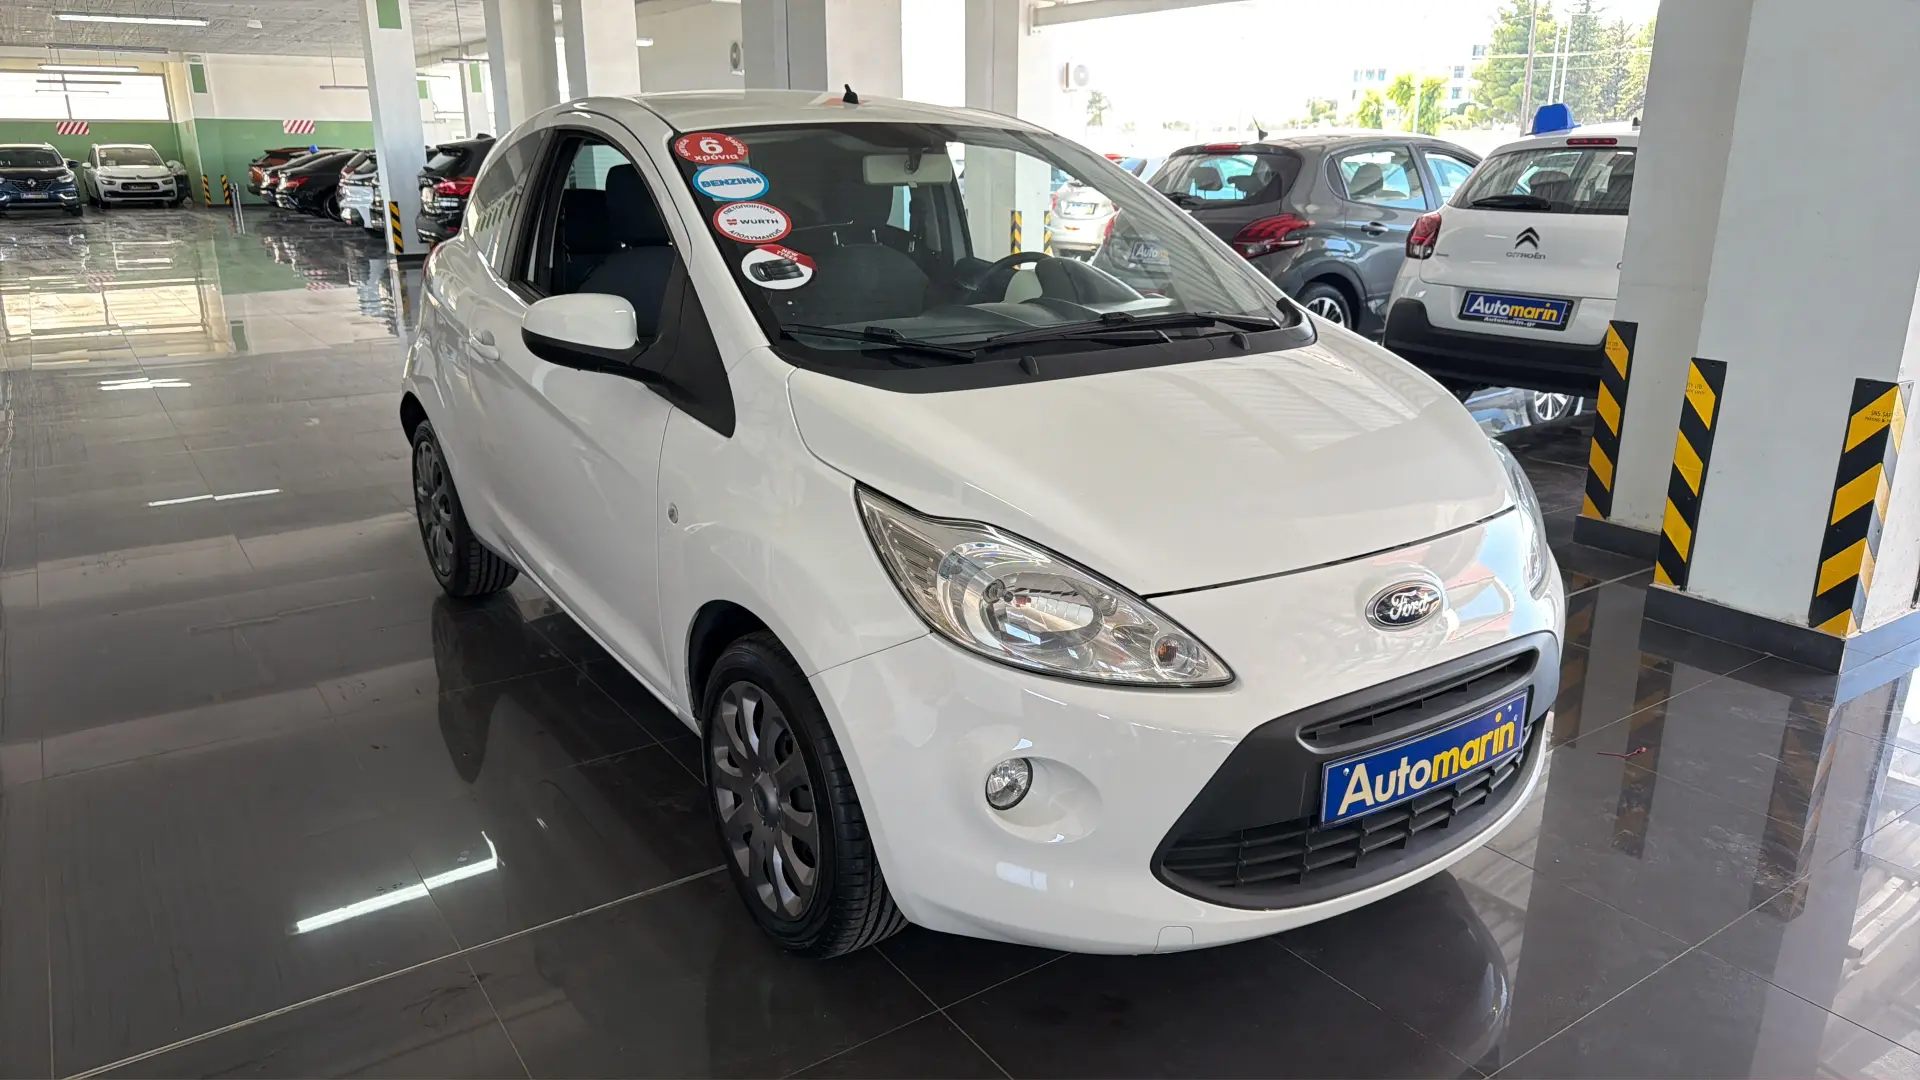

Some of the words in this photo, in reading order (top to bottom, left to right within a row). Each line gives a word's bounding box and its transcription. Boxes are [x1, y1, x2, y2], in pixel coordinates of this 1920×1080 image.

[694, 153, 739, 162] χρόνια
[699, 139, 723, 154] 6
[1469, 296, 1558, 322] Automarin
[1389, 589, 1431, 620] Ford
[1337, 711, 1516, 815] Automarin
